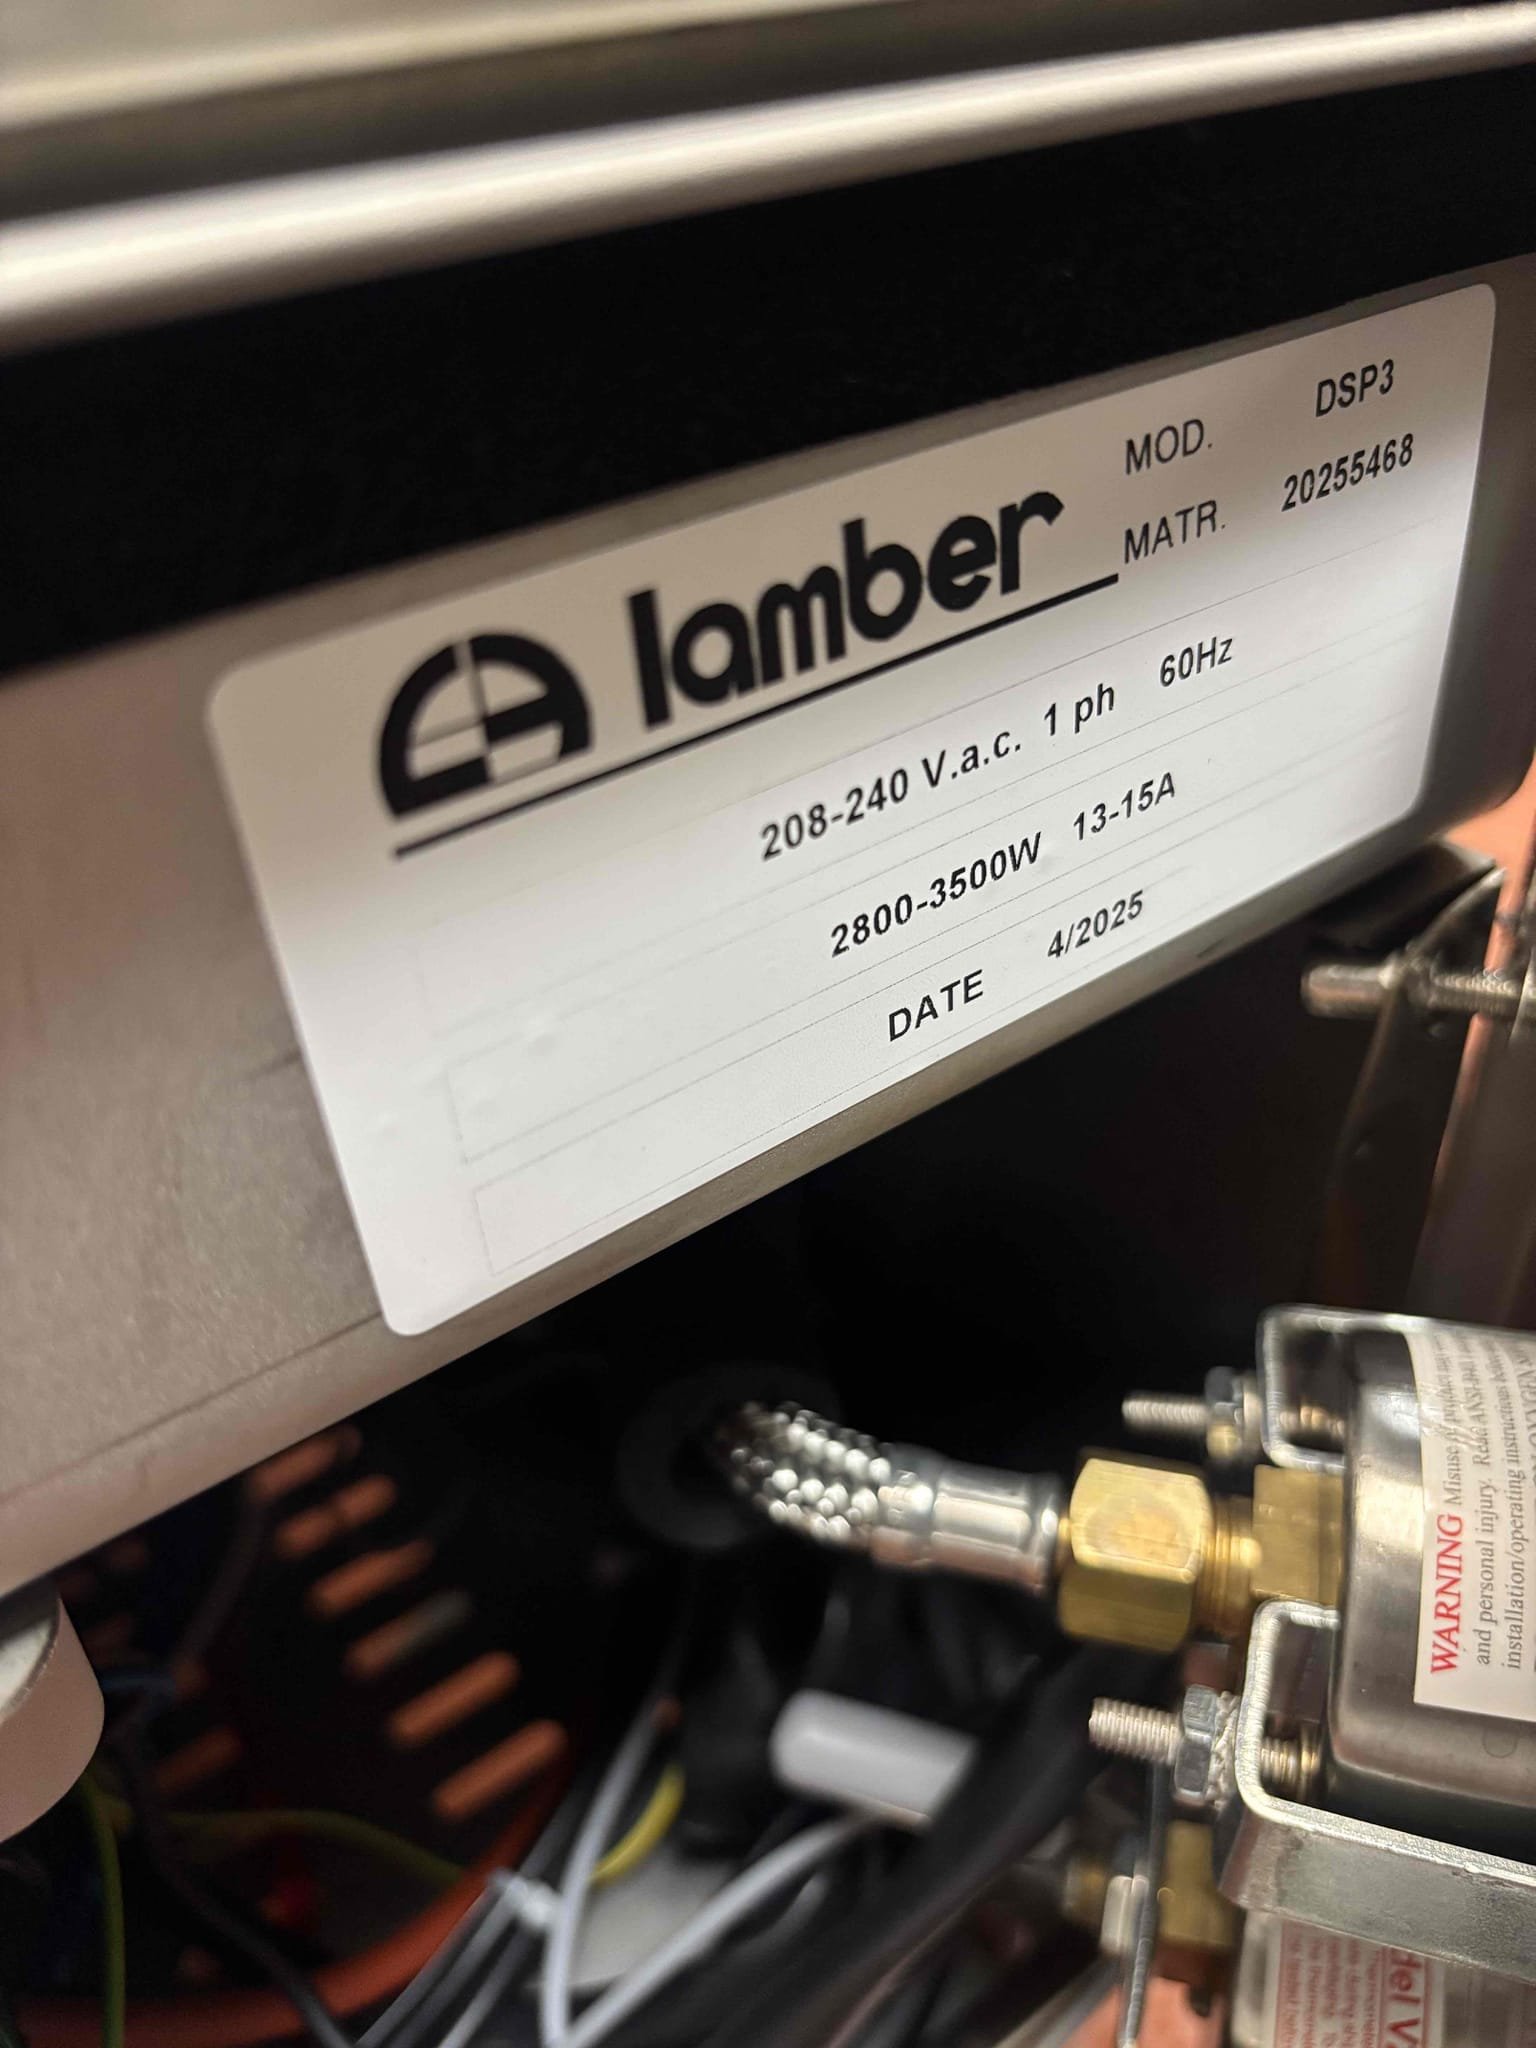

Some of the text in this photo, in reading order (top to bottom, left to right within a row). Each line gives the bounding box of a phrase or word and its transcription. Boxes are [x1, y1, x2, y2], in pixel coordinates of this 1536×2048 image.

[1125, 358, 1395, 476] MOD. DSP3
[1124, 433, 1414, 564] MATR. 20255468
[626, 491, 1065, 733] lamber
[760, 635, 1234, 861] 208-240 V.a.c. 1 ph 60Hz
[830, 772, 1176, 958] 2800-3500W 13-15A
[889, 890, 1144, 1042] DATE 4/2025
[1443, 1446, 1462, 1506] Misuse
[1475, 1478, 1499, 1534] injury.
[1430, 1513, 1464, 1674] WARNING
[1475, 1540, 1499, 1626] personal
[1501, 1468, 1529, 1671] installation/operating
[1472, 1628, 1492, 1665] and
